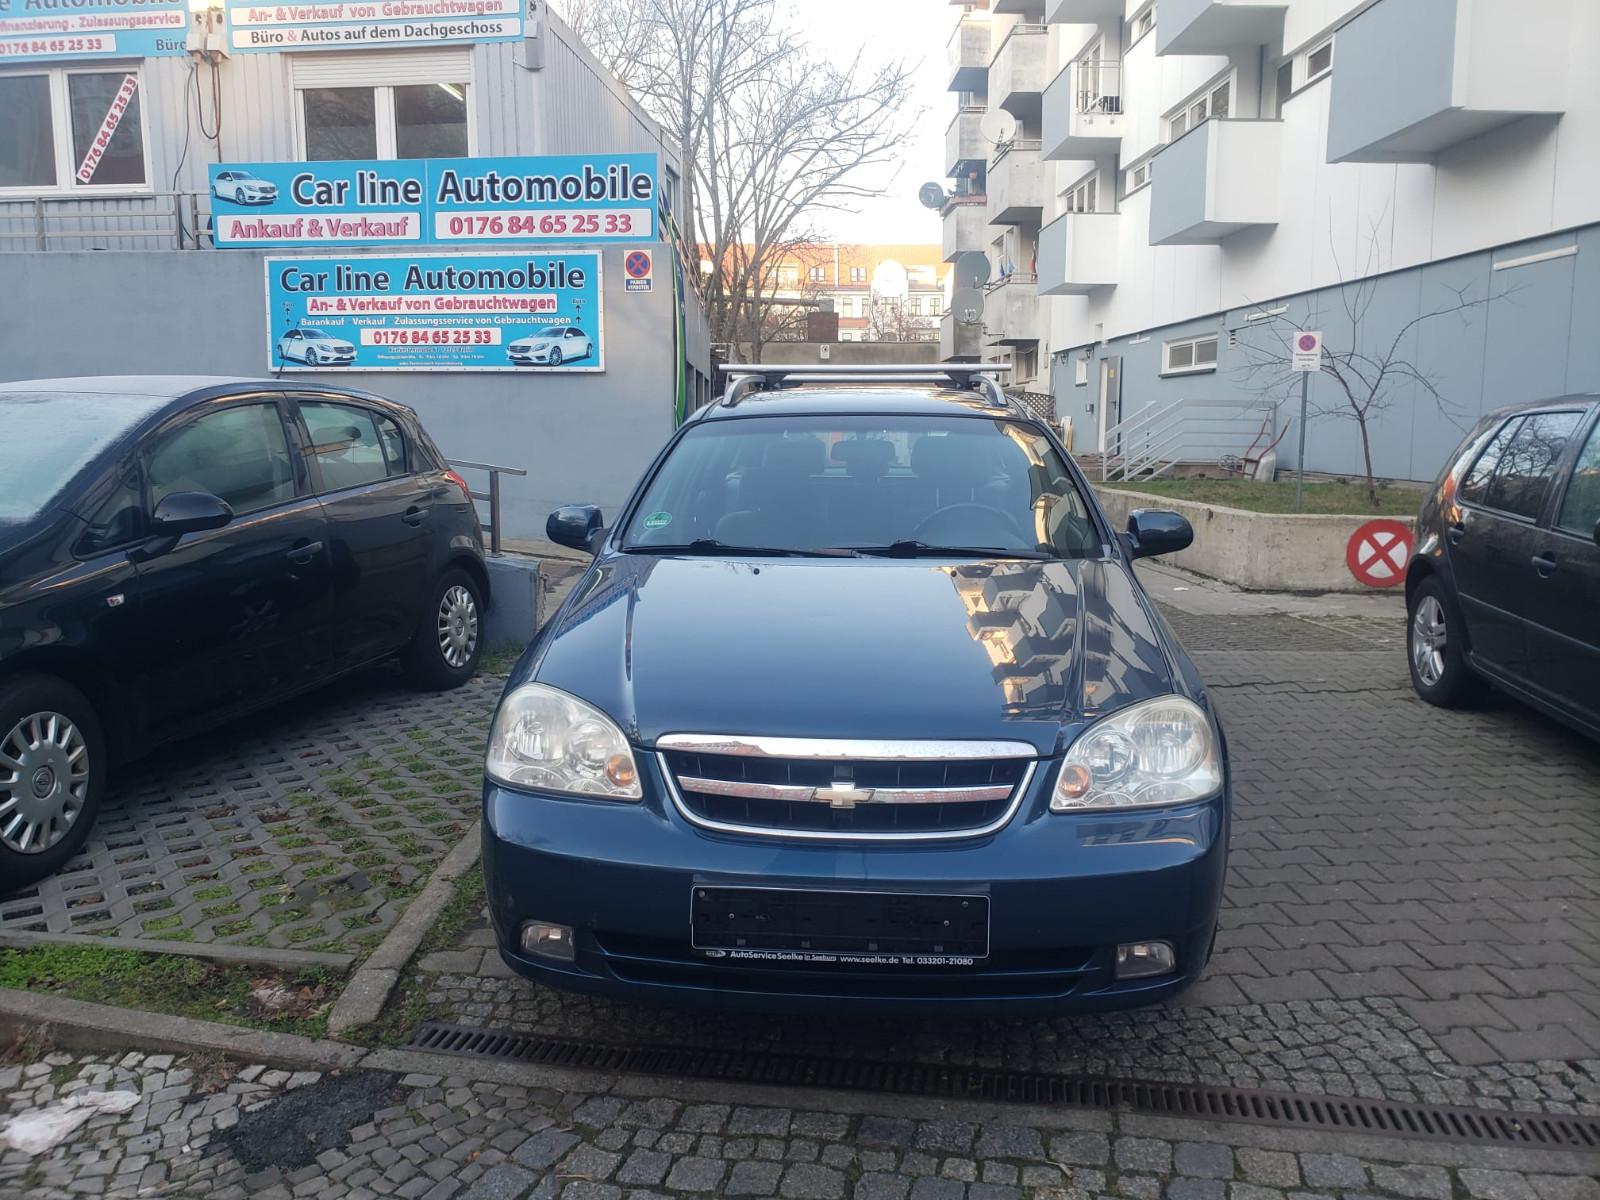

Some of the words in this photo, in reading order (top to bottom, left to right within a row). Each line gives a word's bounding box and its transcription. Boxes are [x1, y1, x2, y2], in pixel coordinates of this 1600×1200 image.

[79, 14, 181, 28] Zulassungsservice
[276, 8, 286, 21] &
[288, 4, 344, 20] Verkauf
[351, 6, 376, 18] von
[382, 0, 503, 16] Gebrauchtwagen
[251, 31, 284, 44] Büro
[287, 30, 297, 42] &
[301, 29, 341, 42] Autos
[344, 26, 367, 40] auf
[370, 24, 401, 39] dem
[404, 21, 503, 38] Dachgeschoss
[32, 41, 47, 53] 84
[50, 40, 65, 51] 65
[68, 39, 83, 51] 25
[87, 38, 103, 50] 33
[80, 148, 102, 179] 0176
[96, 130, 111, 148] 84
[106, 112, 119, 130] 65
[114, 95, 128, 113] 25
[122, 78, 137, 95] 33
[291, 173, 350, 206] Car
[357, 170, 422, 205] line
[436, 164, 652, 204] Automobile
[230, 218, 304, 239] Ankauf
[307, 218, 323, 237] &
[326, 216, 409, 236] Verkauf
[449, 216, 504, 235] 0176
[508, 216, 535, 234] 84
[540, 215, 567, 233] 65
[572, 215, 600, 233] 25
[605, 214, 632, 233] 33
[281, 267, 328, 292] Car
[335, 264, 390, 292] line
[404, 260, 585, 291] Automobile
[310, 298, 333, 312] An-
[336, 298, 346, 311] &
[349, 297, 403, 311] Verkauf
[405, 299, 431, 310] von
[434, 296, 556, 312] Gebrauchtwagen
[301, 317, 345, 326] Barankauf
[352, 317, 386, 325] Verkauf
[394, 316, 473, 326] Zulassungsservice
[475, 317, 492, 325] von
[494, 315, 571, 326] Gebrauchtwagen
[373, 330, 409, 344] 0176
[411, 330, 429, 344] 84
[432, 330, 449, 344] 65
[453, 330, 471, 344] 25
[474, 330, 492, 344] 33
[902, 956, 915, 965] Tel.
[917, 957, 974, 966] 033201-21080
